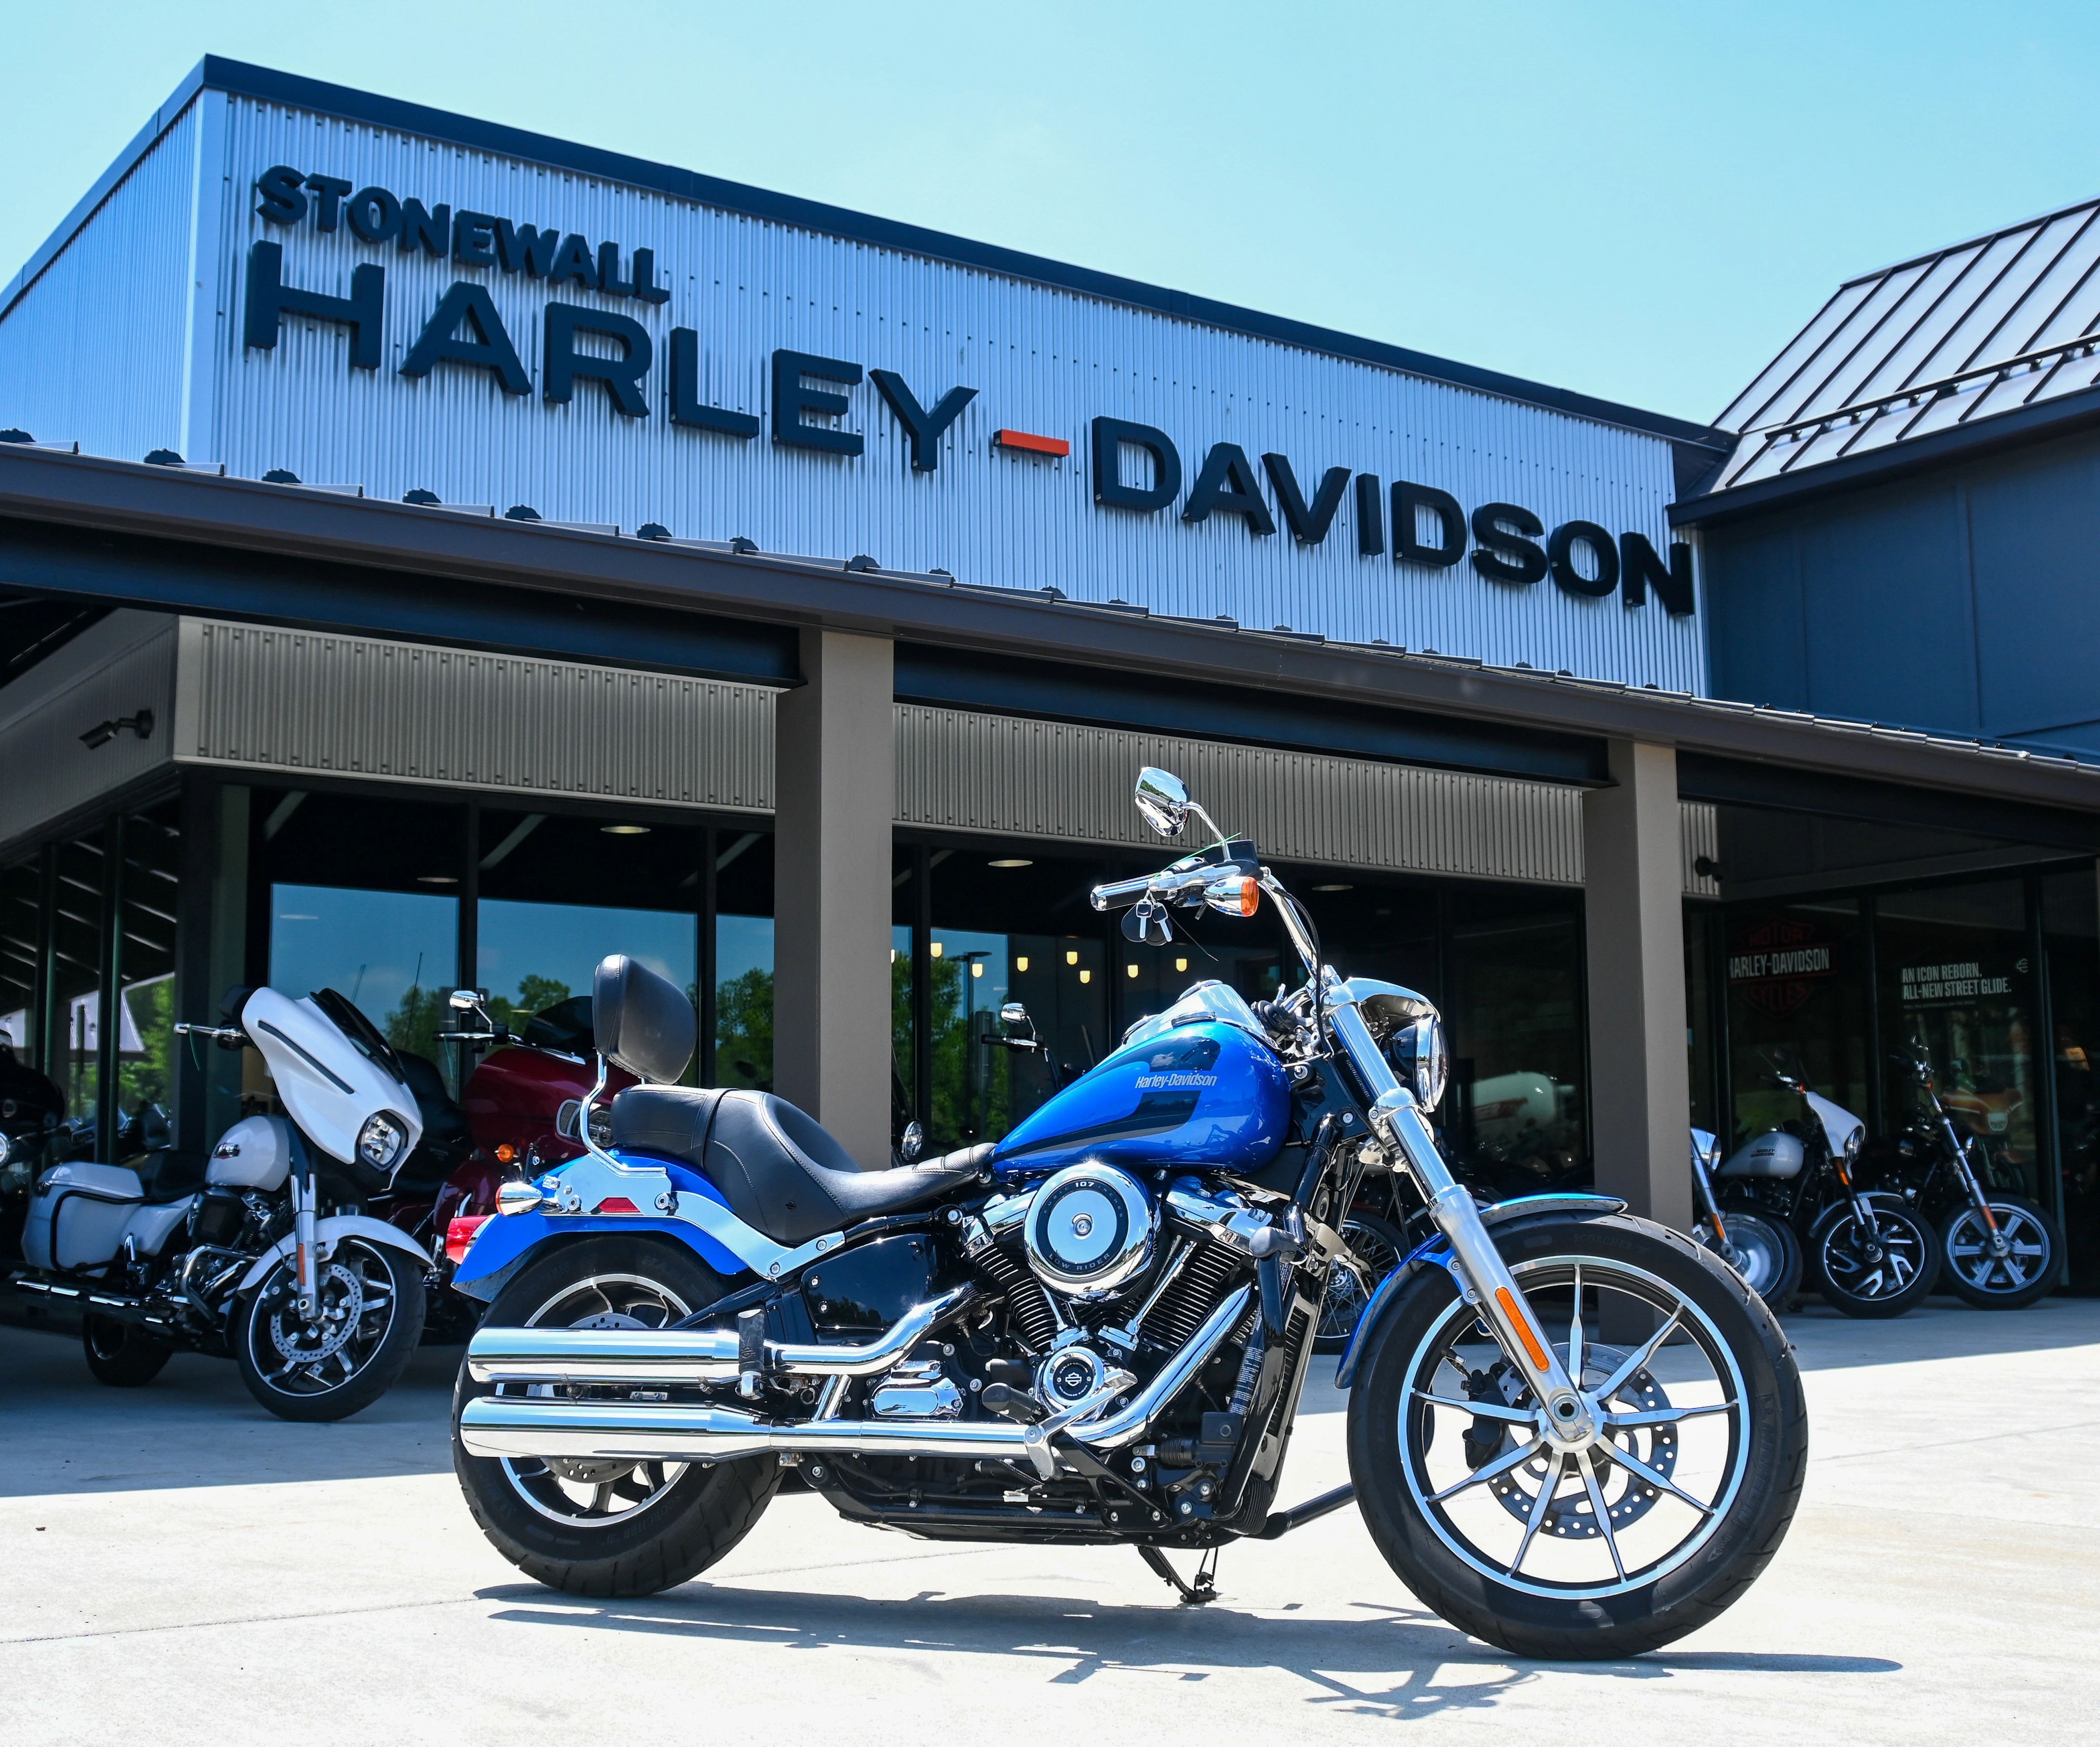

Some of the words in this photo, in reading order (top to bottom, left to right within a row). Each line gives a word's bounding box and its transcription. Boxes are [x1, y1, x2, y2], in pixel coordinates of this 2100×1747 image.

[255, 165, 670, 304] STONEWALL
[1902, 968, 1915, 983] AN
[1917, 965, 1939, 982] ICON
[1942, 962, 1982, 980] REBORN.
[1902, 983, 1943, 1000] ALL-NEW
[1945, 979, 1979, 996] STREET
[1981, 977, 2012, 995] GLIDE.
[1135, 1072, 1217, 1089] Harley-Davidson
[1043, 1186, 1070, 1214] CUBIC
[1098, 1185, 1123, 1218] INCHES
[1573, 1233, 1633, 1250] SCORCHER
[1048, 1253, 1070, 1269] LOW
[1076, 1252, 1110, 1271] RIDER
[623, 1491, 684, 1539] SCORCHER
